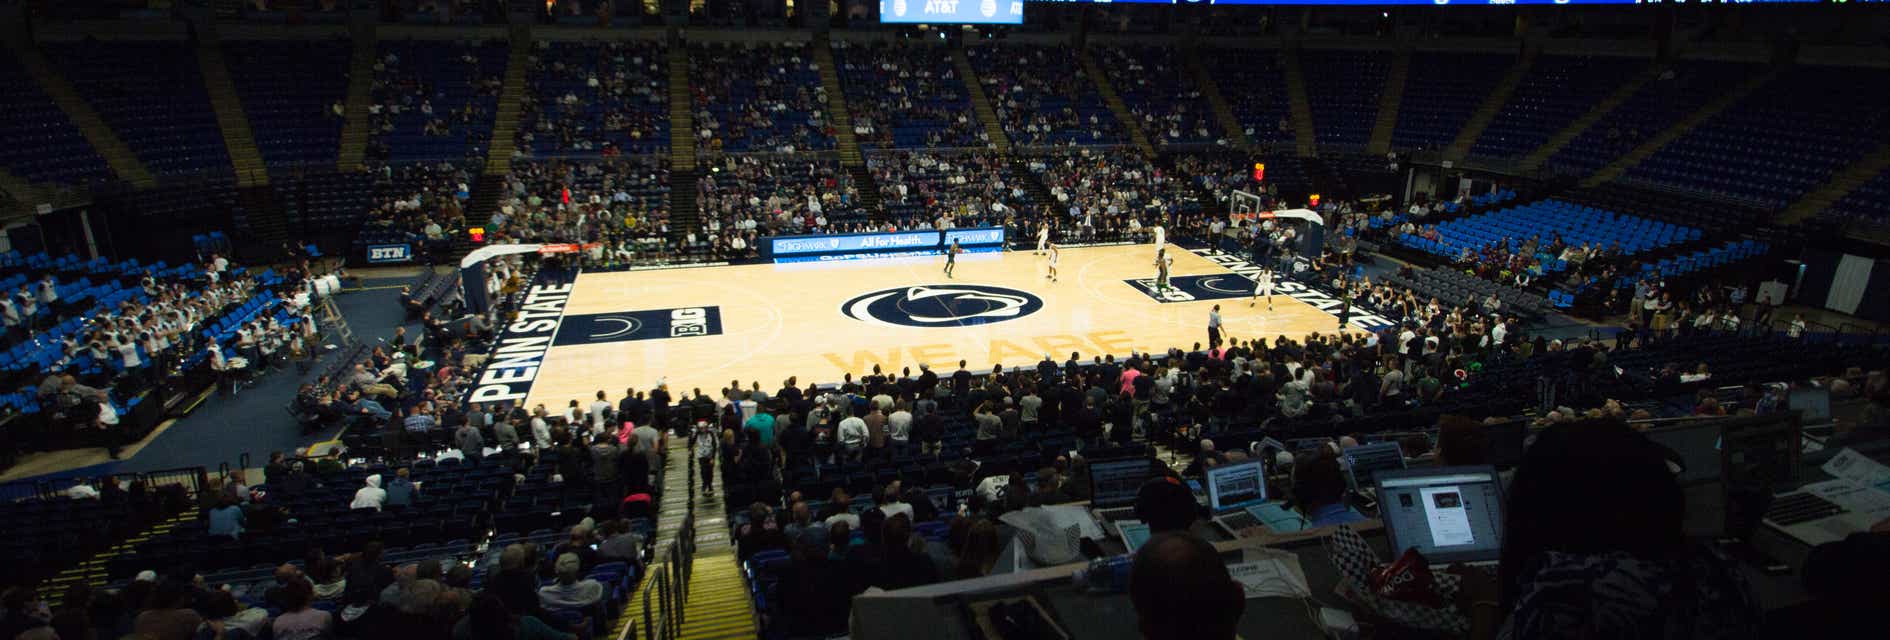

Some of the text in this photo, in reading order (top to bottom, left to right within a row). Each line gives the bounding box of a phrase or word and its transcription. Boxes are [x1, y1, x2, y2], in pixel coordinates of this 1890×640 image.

[924, 0, 959, 14] AT&T
[371, 247, 405, 259] BTN
[861, 237, 874, 247] All
[1274, 281, 1395, 329] STATE
[468, 283, 574, 403] PENN STATE
[820, 330, 1136, 374] WE ARE
